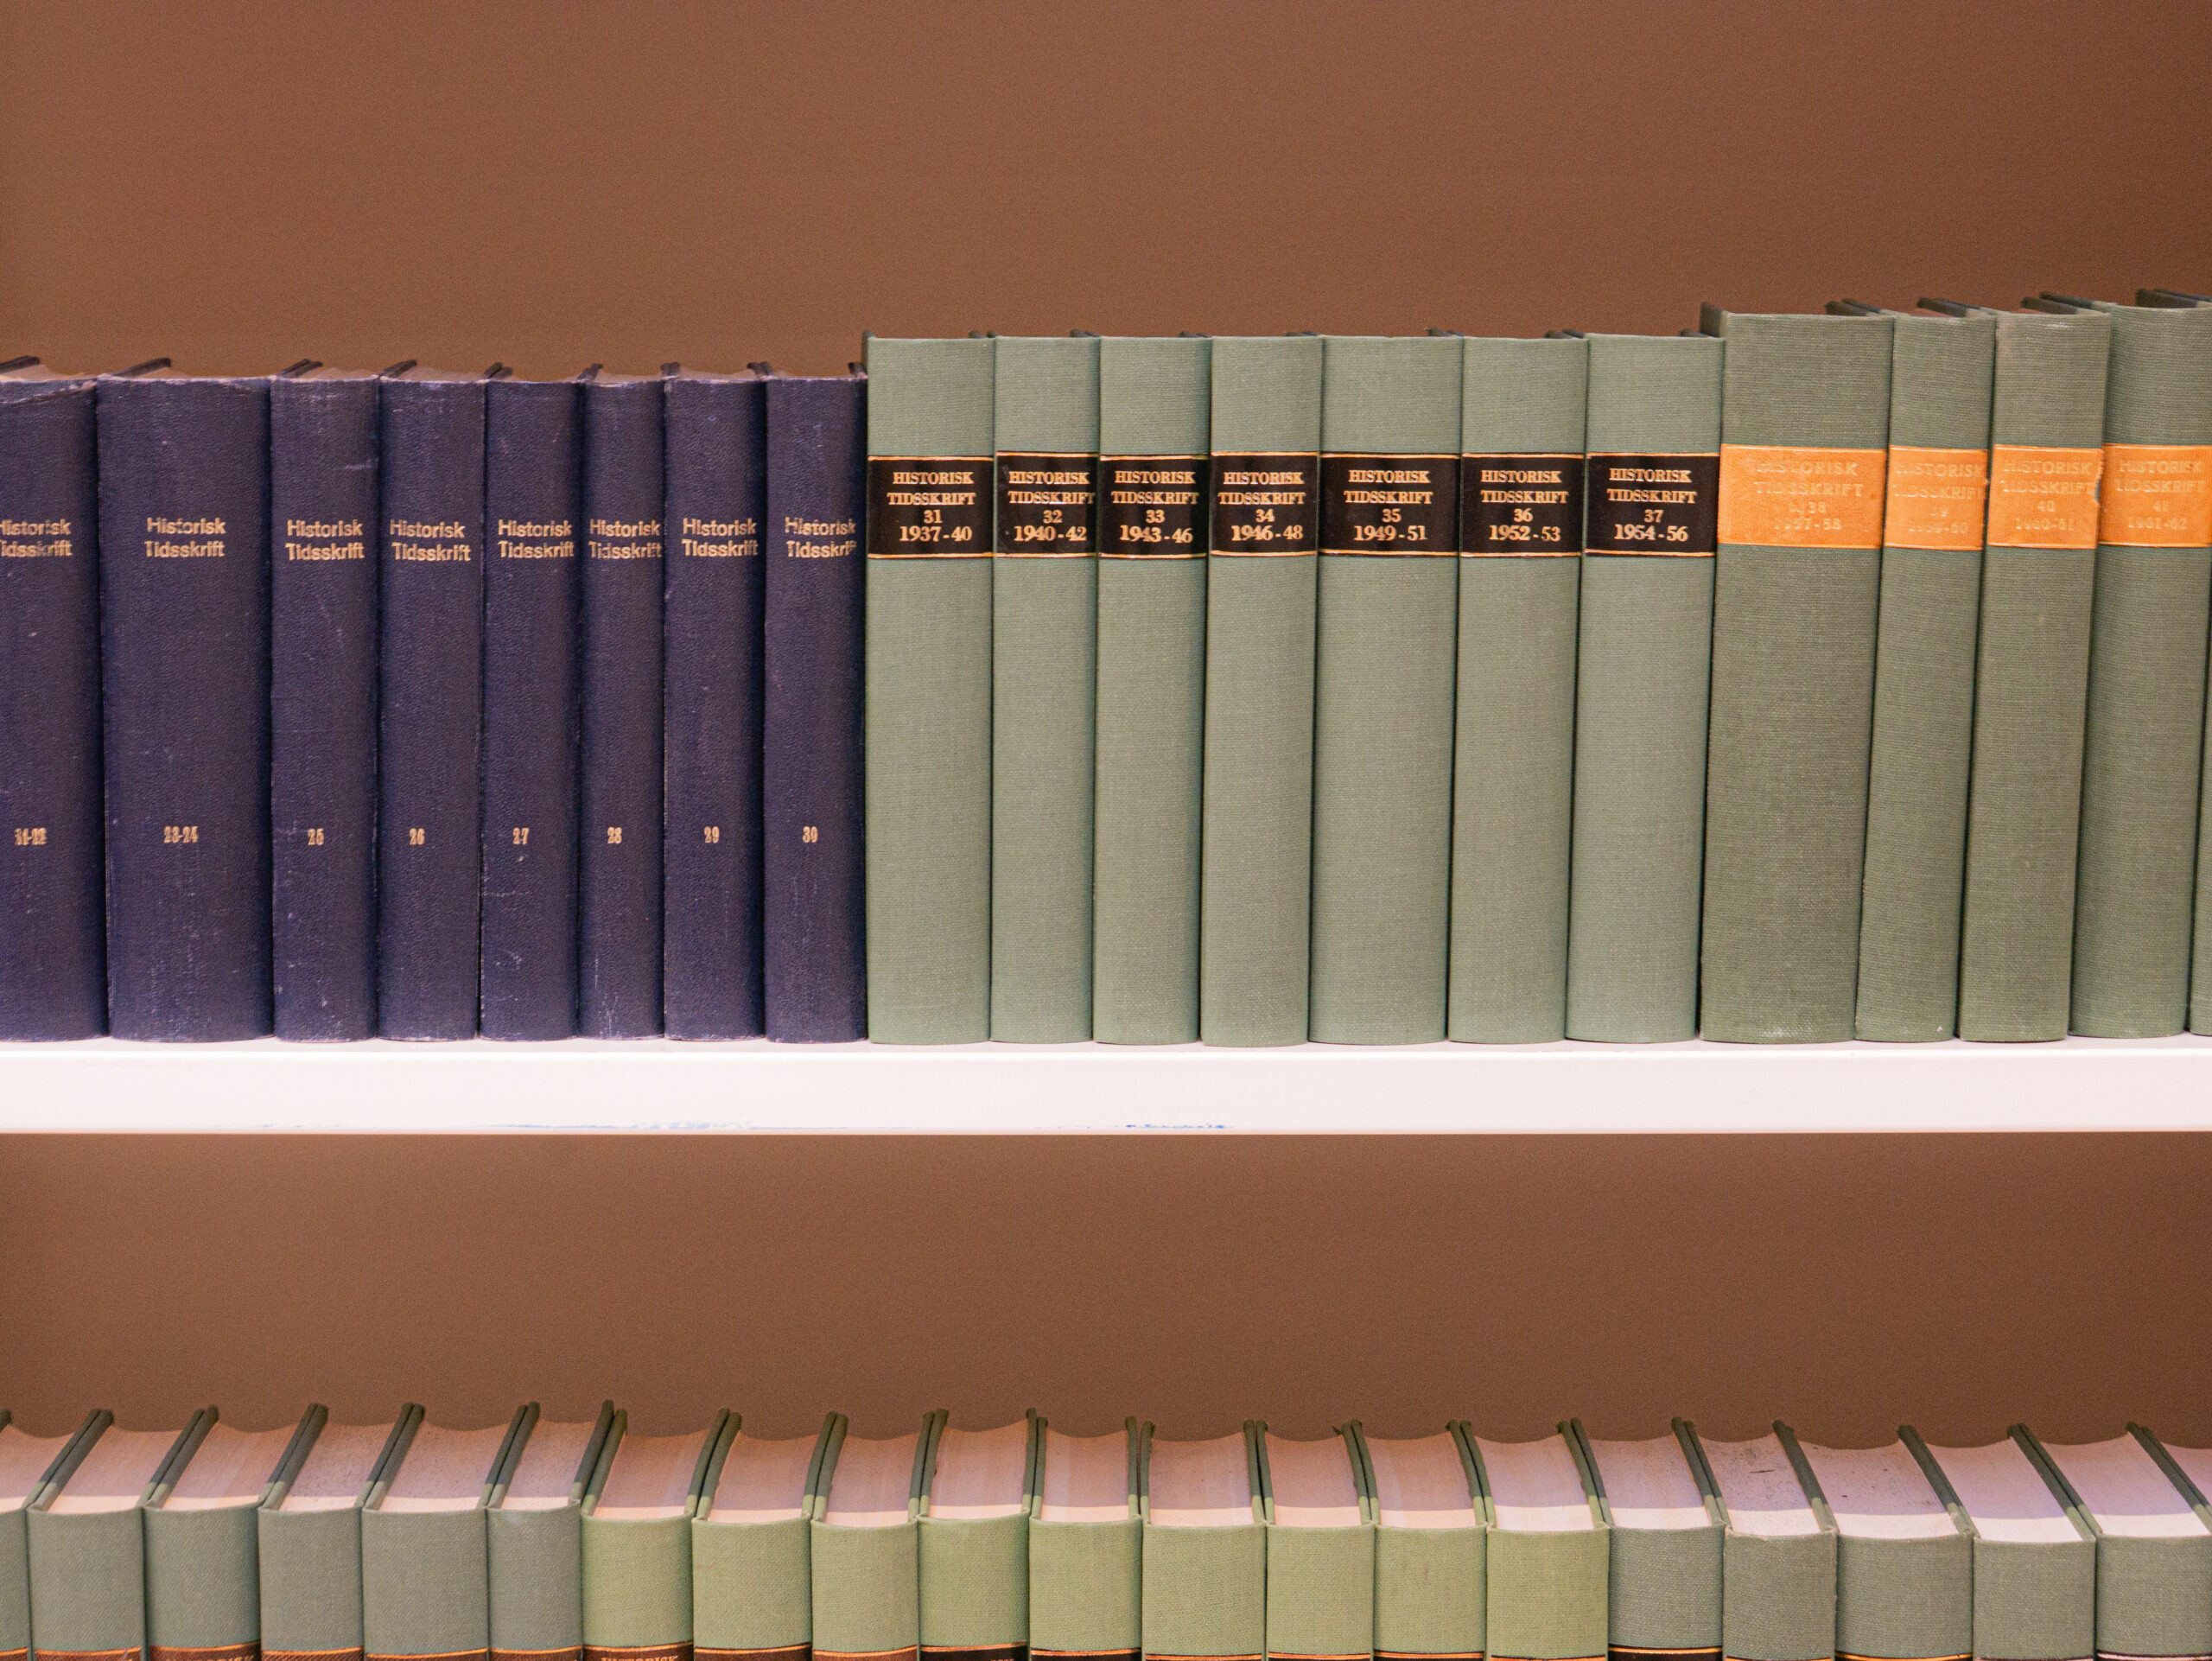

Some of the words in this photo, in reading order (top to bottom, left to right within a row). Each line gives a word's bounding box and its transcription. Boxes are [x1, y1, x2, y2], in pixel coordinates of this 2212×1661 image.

[893, 472, 974, 484] HISTORISK
[1008, 471, 1090, 484] HISTORISK
[1115, 471, 1196, 484] HISTORISK
[1224, 472, 1305, 485] HISTORISK
[1348, 470, 1431, 483] HISTORISK
[1481, 470, 1562, 483] HISTORISK
[1609, 468, 1692, 483] HISTORISK
[887, 493, 976, 505] TIDSSKRIFT
[1007, 491, 1096, 504] TIDSSKRIFT
[1111, 491, 1199, 505] TIDSSKRIFT
[1217, 492, 1306, 505] TIDSSKRIFT
[1344, 491, 1433, 504] TIDSSKRIFT
[1481, 490, 1568, 503] TIDSSKRIFT
[1606, 488, 1697, 504] TIDSSKRIFT
[924, 510, 943, 524] 31
[1042, 510, 1063, 524] 32
[1145, 510, 1166, 524] 33
[1255, 508, 1274, 522] 34
[1382, 508, 1402, 522] 35
[1514, 508, 1533, 522] 36
[1643, 509, 1663, 523] 37
[147, 518, 226, 534] Historisk
[287, 519, 362, 538] Historisk
[391, 520, 465, 538] Historisk
[499, 519, 571, 538] Historisk
[590, 519, 660, 538] Historisk
[682, 518, 755, 538] Historisk
[785, 517, 855, 536] Historisk
[0, 539, 72, 557] idsskrift
[144, 541, 225, 557] Tidsskrift
[285, 542, 365, 560] Tidsskrift
[391, 542, 471, 562] Tidsskrift
[498, 541, 574, 558] Tidsskrift
[588, 541, 661, 559] Tidsskrift
[682, 540, 757, 557] Tidsskrift
[786, 540, 855, 558] Tidsskrift
[164, 826, 198, 843] 23-24
[308, 828, 324, 845] 25
[410, 828, 424, 845] 26
[513, 828, 529, 844] 27
[607, 827, 622, 843] 28
[704, 826, 719, 843] 29
[803, 826, 817, 843] 30
